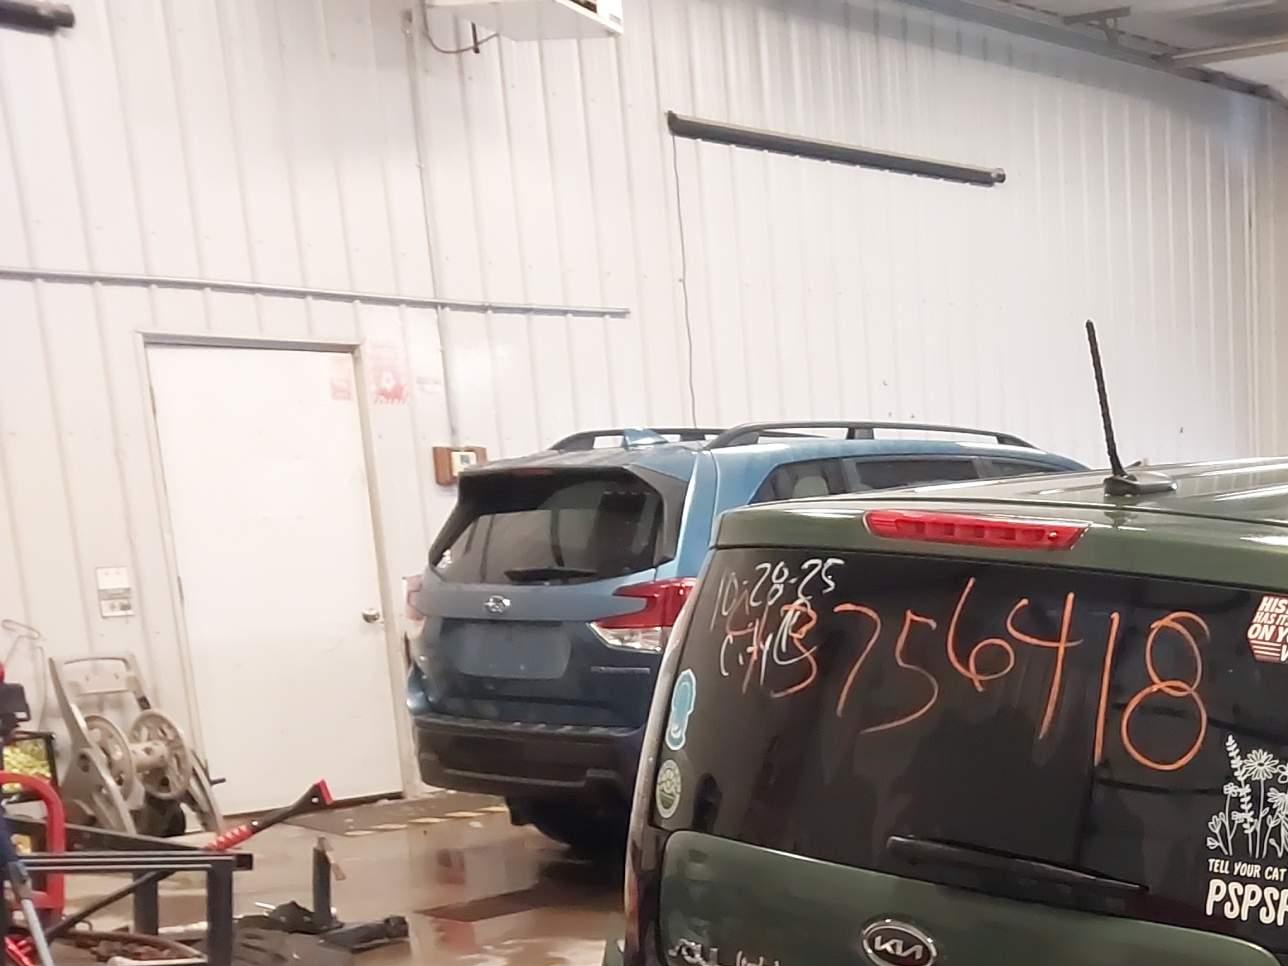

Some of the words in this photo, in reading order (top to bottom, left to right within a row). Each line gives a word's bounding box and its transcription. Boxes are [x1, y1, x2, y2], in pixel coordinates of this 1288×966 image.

[1252, 611, 1277, 625] HAS
[1247, 623, 1277, 641] ON
[1208, 858, 1230, 875] TELL
[1233, 861, 1261, 878] YOUR
[1264, 866, 1288, 882] CAT
